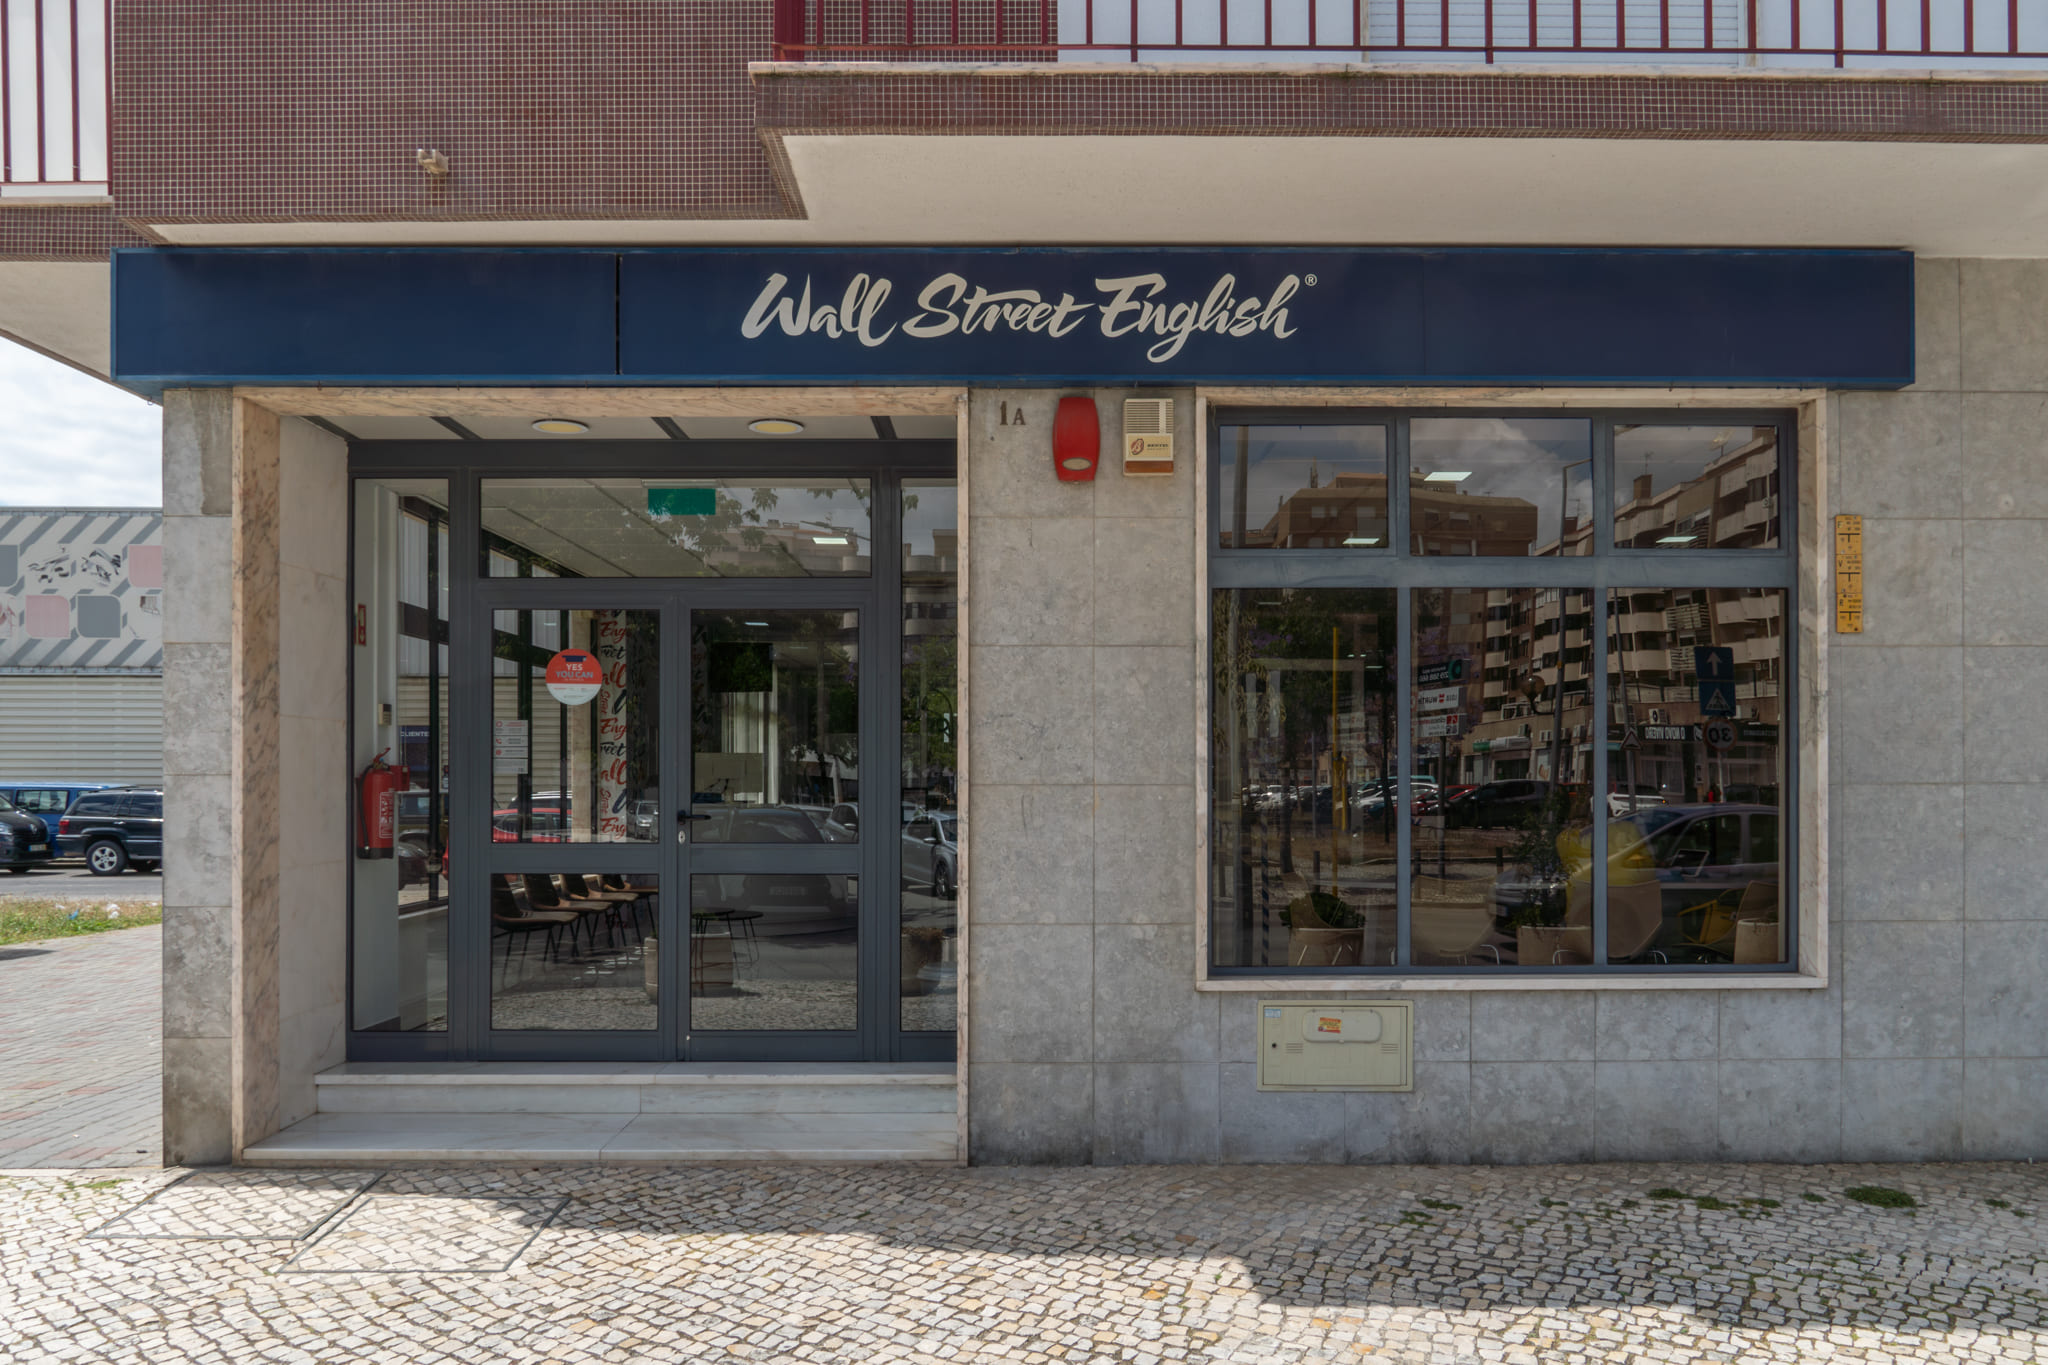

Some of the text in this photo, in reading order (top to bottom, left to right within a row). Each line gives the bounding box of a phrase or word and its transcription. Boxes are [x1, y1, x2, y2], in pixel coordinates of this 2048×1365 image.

[741, 273, 898, 347] Wall
[901, 272, 1095, 338] Street
[566, 663, 584, 671] YES
